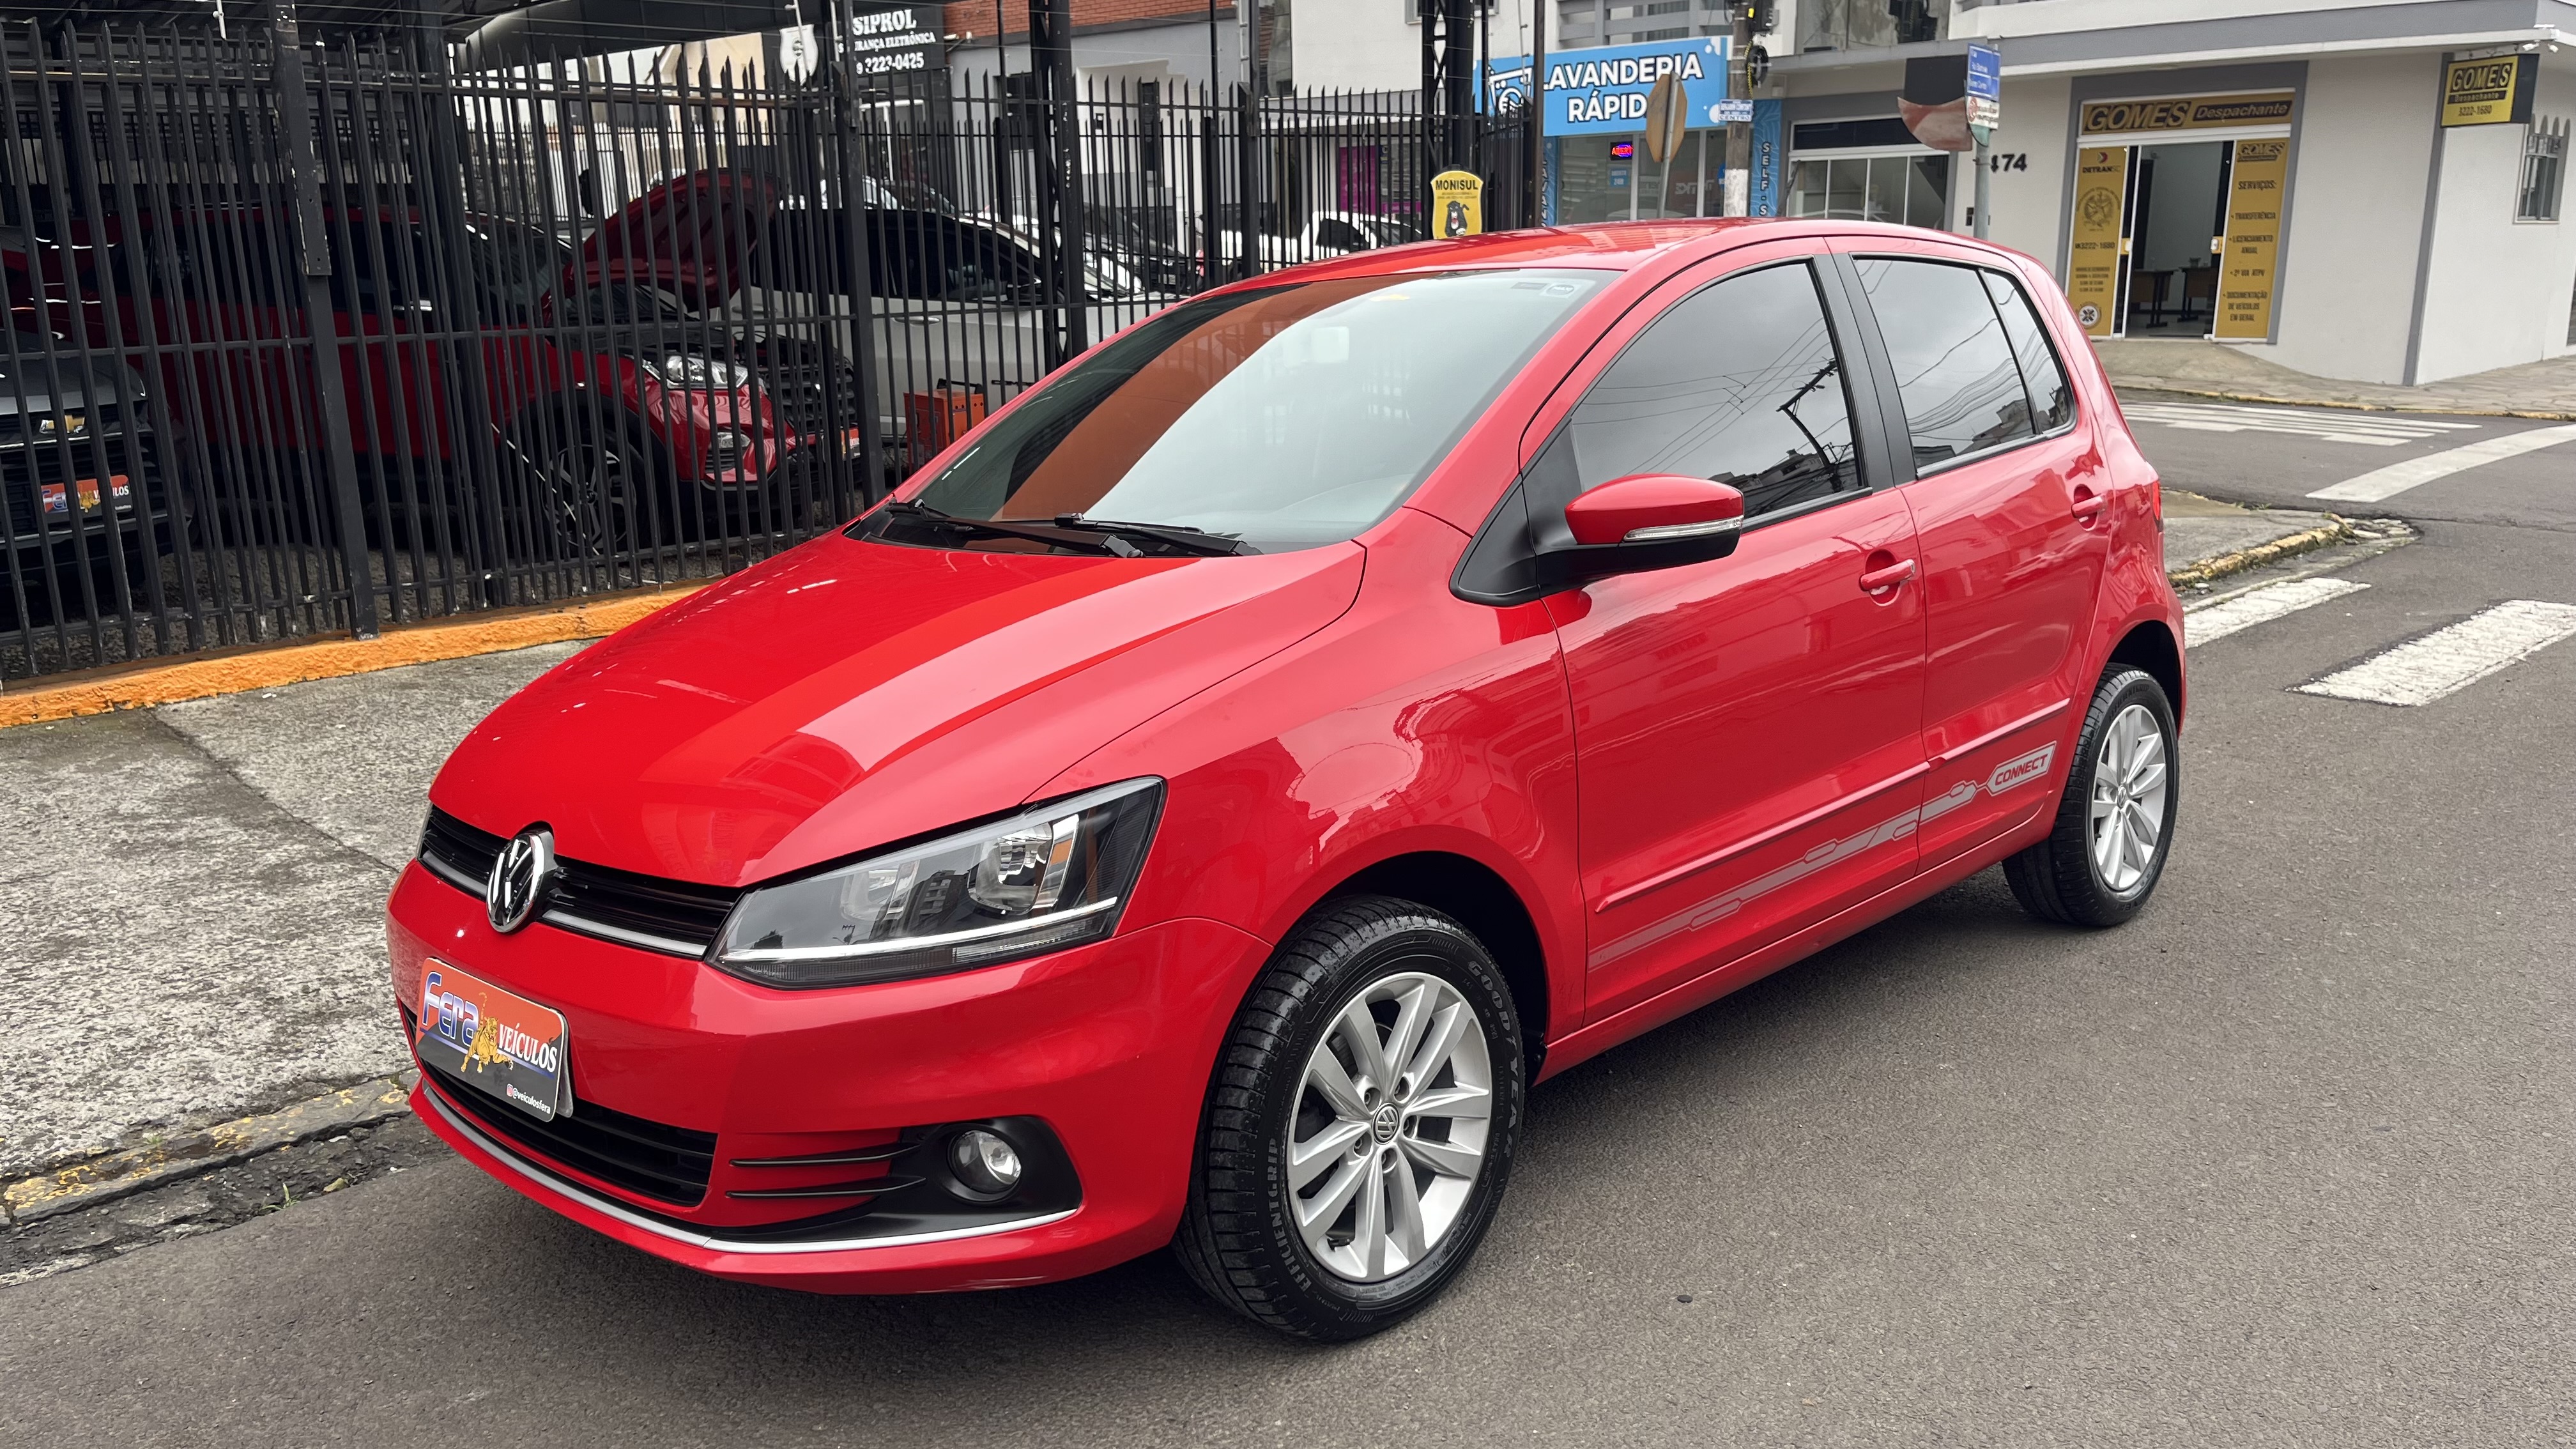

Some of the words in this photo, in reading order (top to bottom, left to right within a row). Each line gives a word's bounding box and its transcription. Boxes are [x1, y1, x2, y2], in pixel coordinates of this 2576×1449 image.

[852, 9, 917, 36] SIPROL
[885, 31, 936, 49] ELETRÔNICA
[1543, 52, 1705, 91] AVANDERIA
[2453, 65, 2511, 91] GOMES
[1567, 88, 1648, 123] RÁPID
[2086, 101, 2191, 131] GOMES
[2196, 103, 2288, 119] Despachante
[2239, 142, 2285, 155] GOMES
[1435, 180, 1479, 190] MONISUL
[1995, 754, 2048, 786] CONNECT
[498, 1022, 558, 1073] VEÍCULOS
[1468, 961, 1519, 1158] GOODYEAR
[512, 1087, 551, 1115] @veiculosfera
